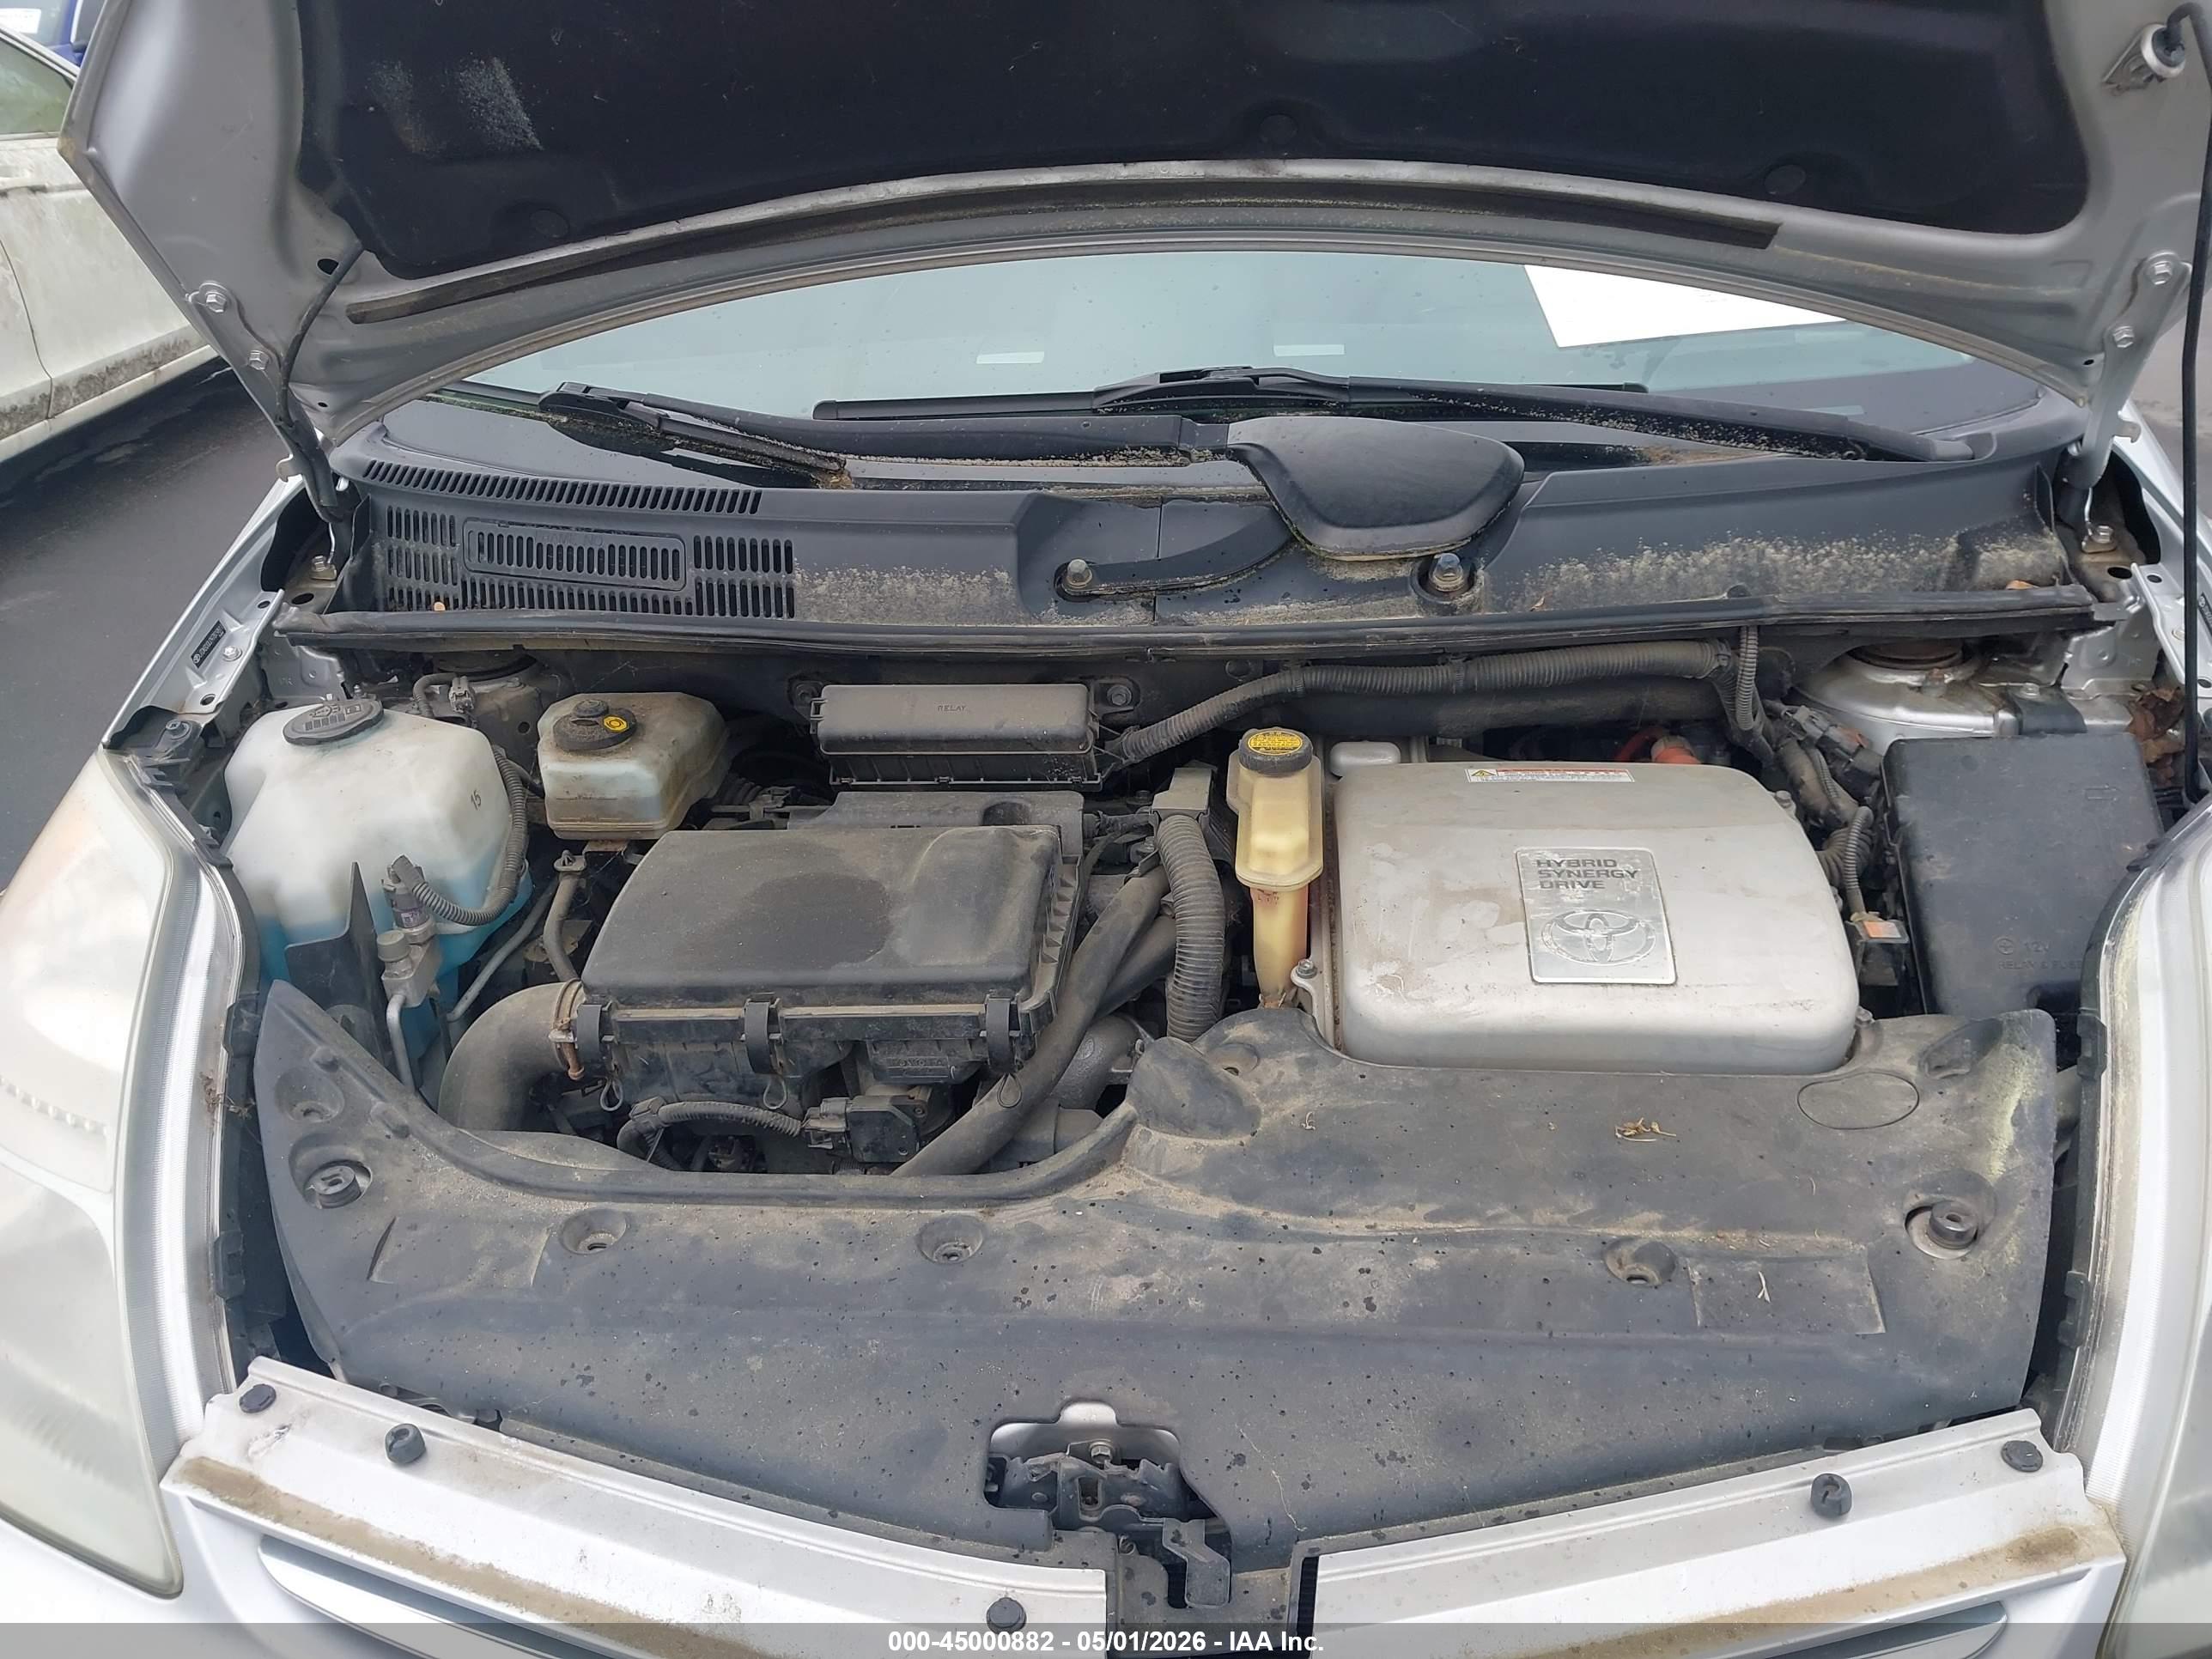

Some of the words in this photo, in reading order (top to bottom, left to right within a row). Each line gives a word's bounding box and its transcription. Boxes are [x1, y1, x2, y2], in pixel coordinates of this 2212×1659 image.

[937, 704, 967, 713] RELAY
[1536, 859, 1618, 868] HYBRID
[1538, 869, 1639, 879] SYNERGY
[1540, 879, 1606, 890] DRIVE
